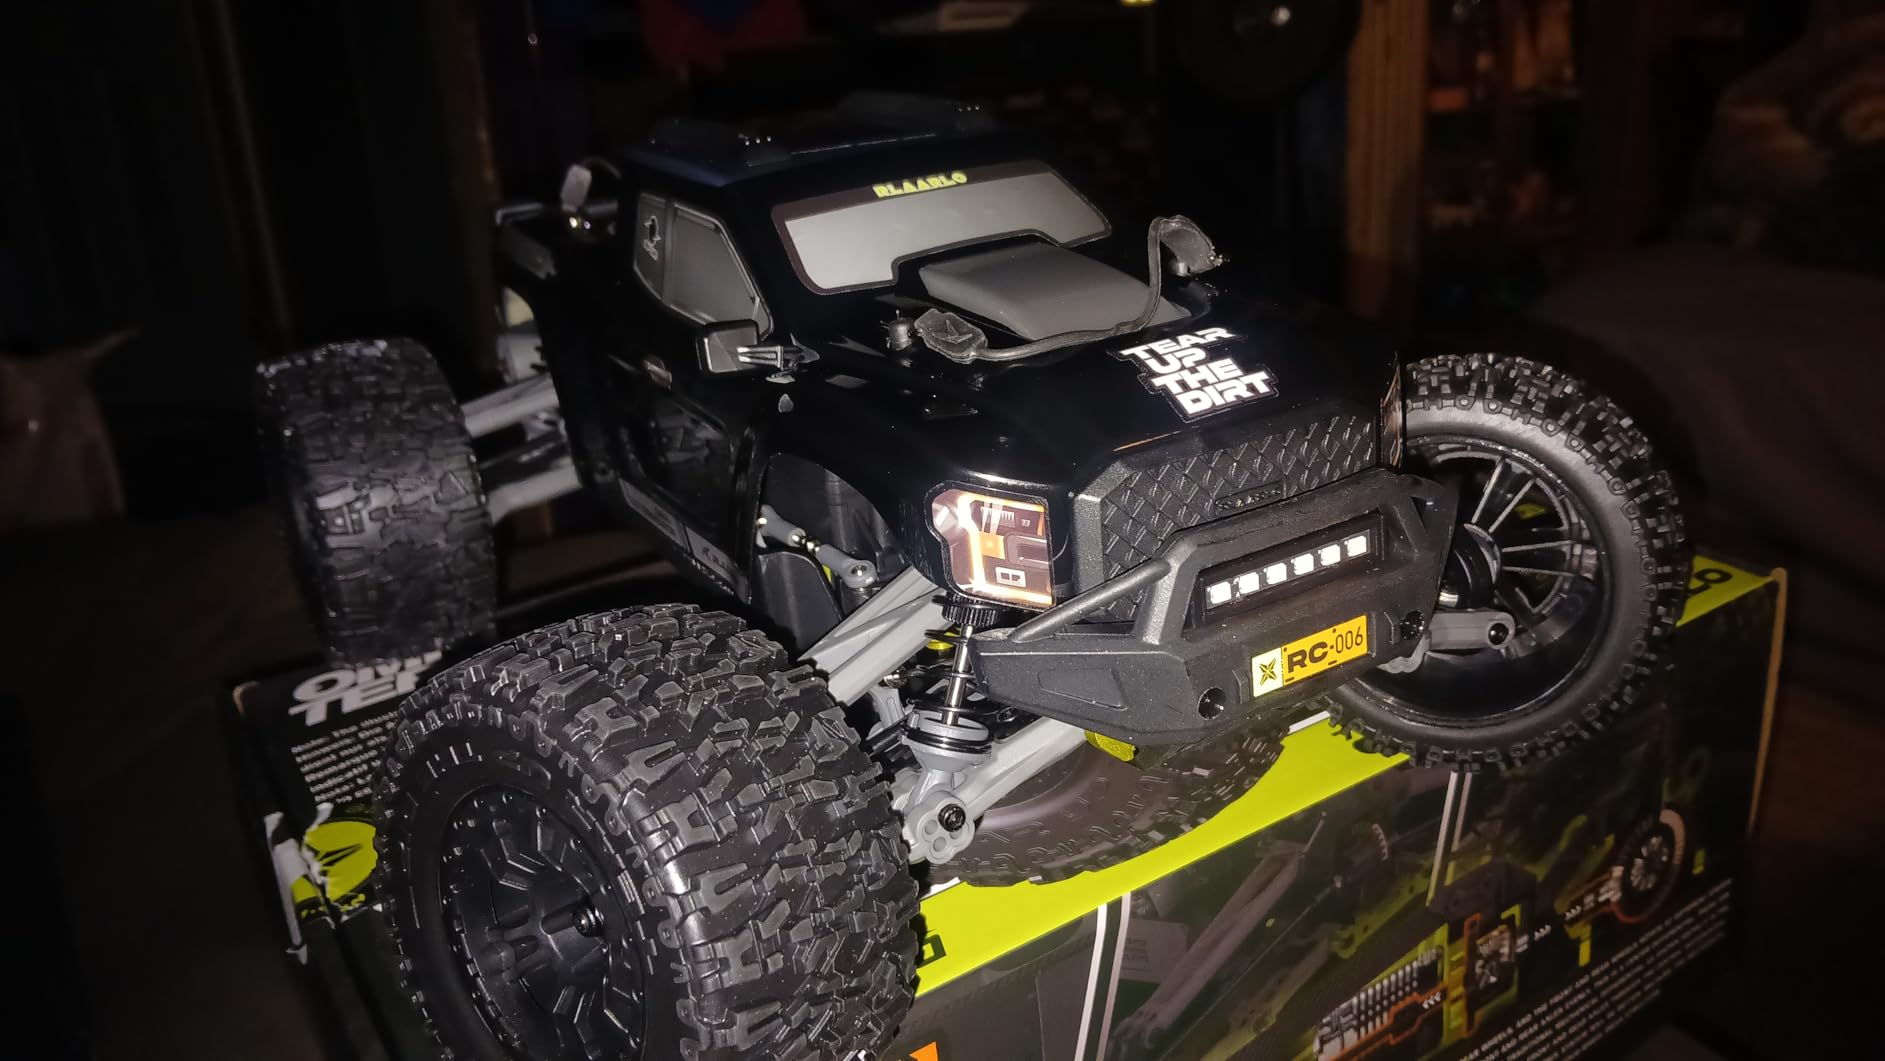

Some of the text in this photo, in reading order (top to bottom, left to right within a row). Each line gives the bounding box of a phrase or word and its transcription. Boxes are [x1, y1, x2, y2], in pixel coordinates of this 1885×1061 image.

[1120, 327, 1237, 360] TEAR
[1145, 347, 1208, 374] UP
[1151, 357, 1244, 394] THE
[1175, 371, 1271, 414] DIRT
